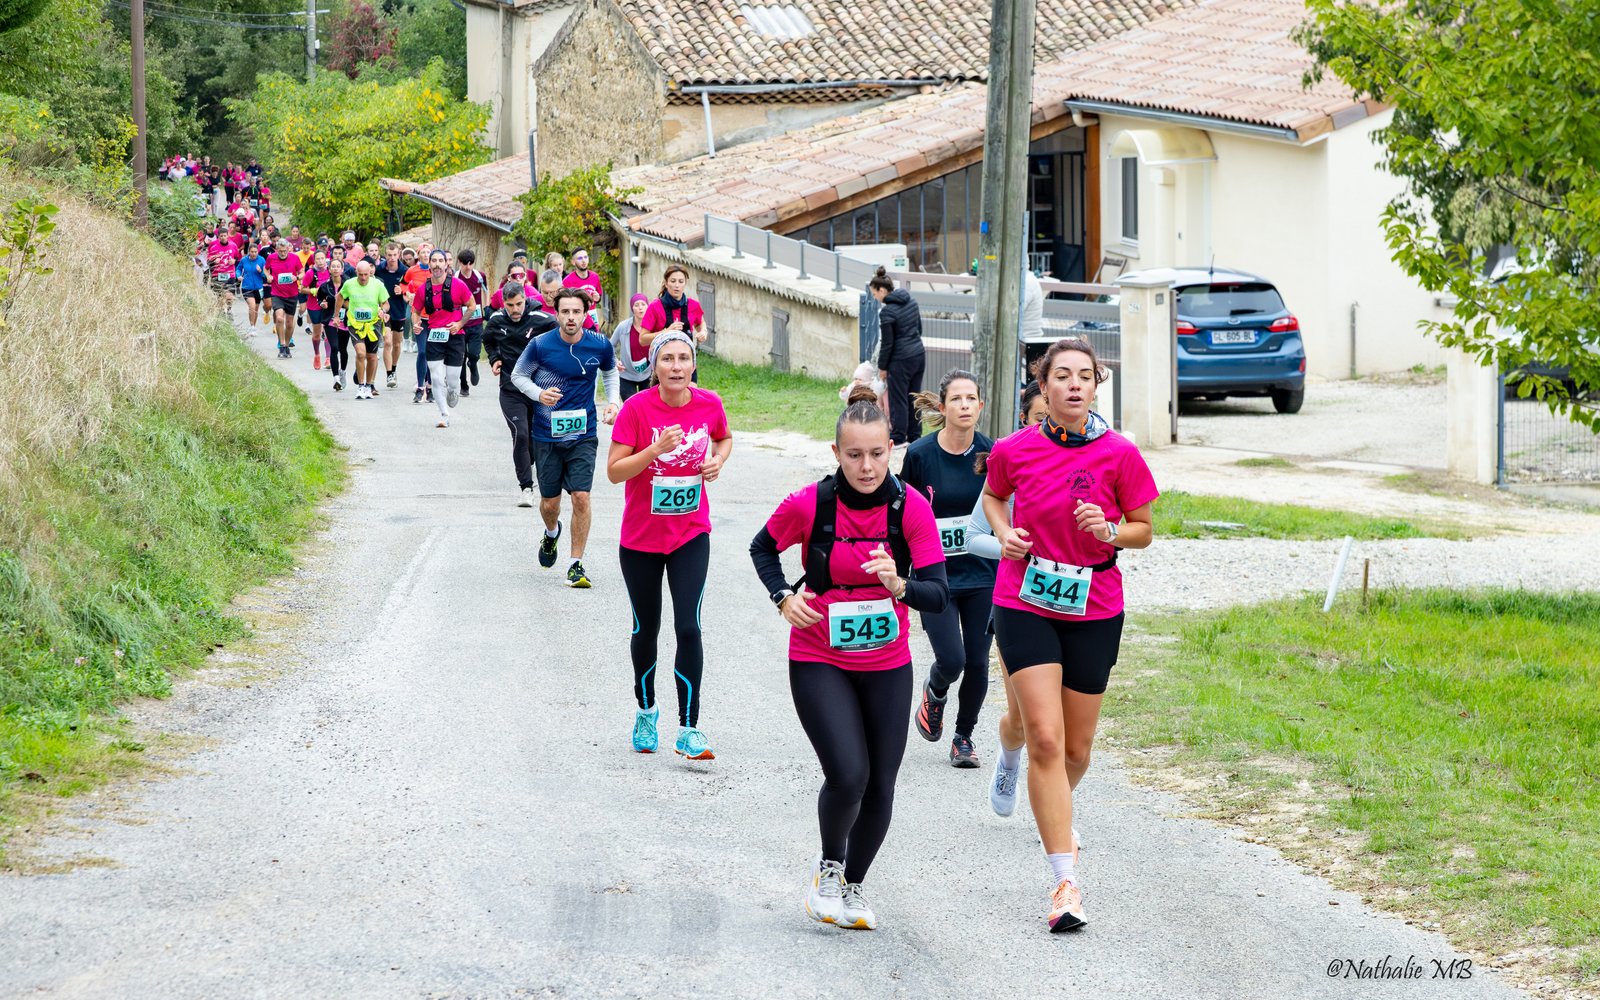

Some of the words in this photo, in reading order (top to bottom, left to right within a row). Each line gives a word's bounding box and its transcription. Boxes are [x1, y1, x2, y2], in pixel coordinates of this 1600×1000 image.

[556, 418, 582, 432] 530
[659, 487, 696, 507] 269
[941, 528, 967, 548] 58
[1030, 572, 1079, 604] 544
[840, 616, 890, 643] 543
